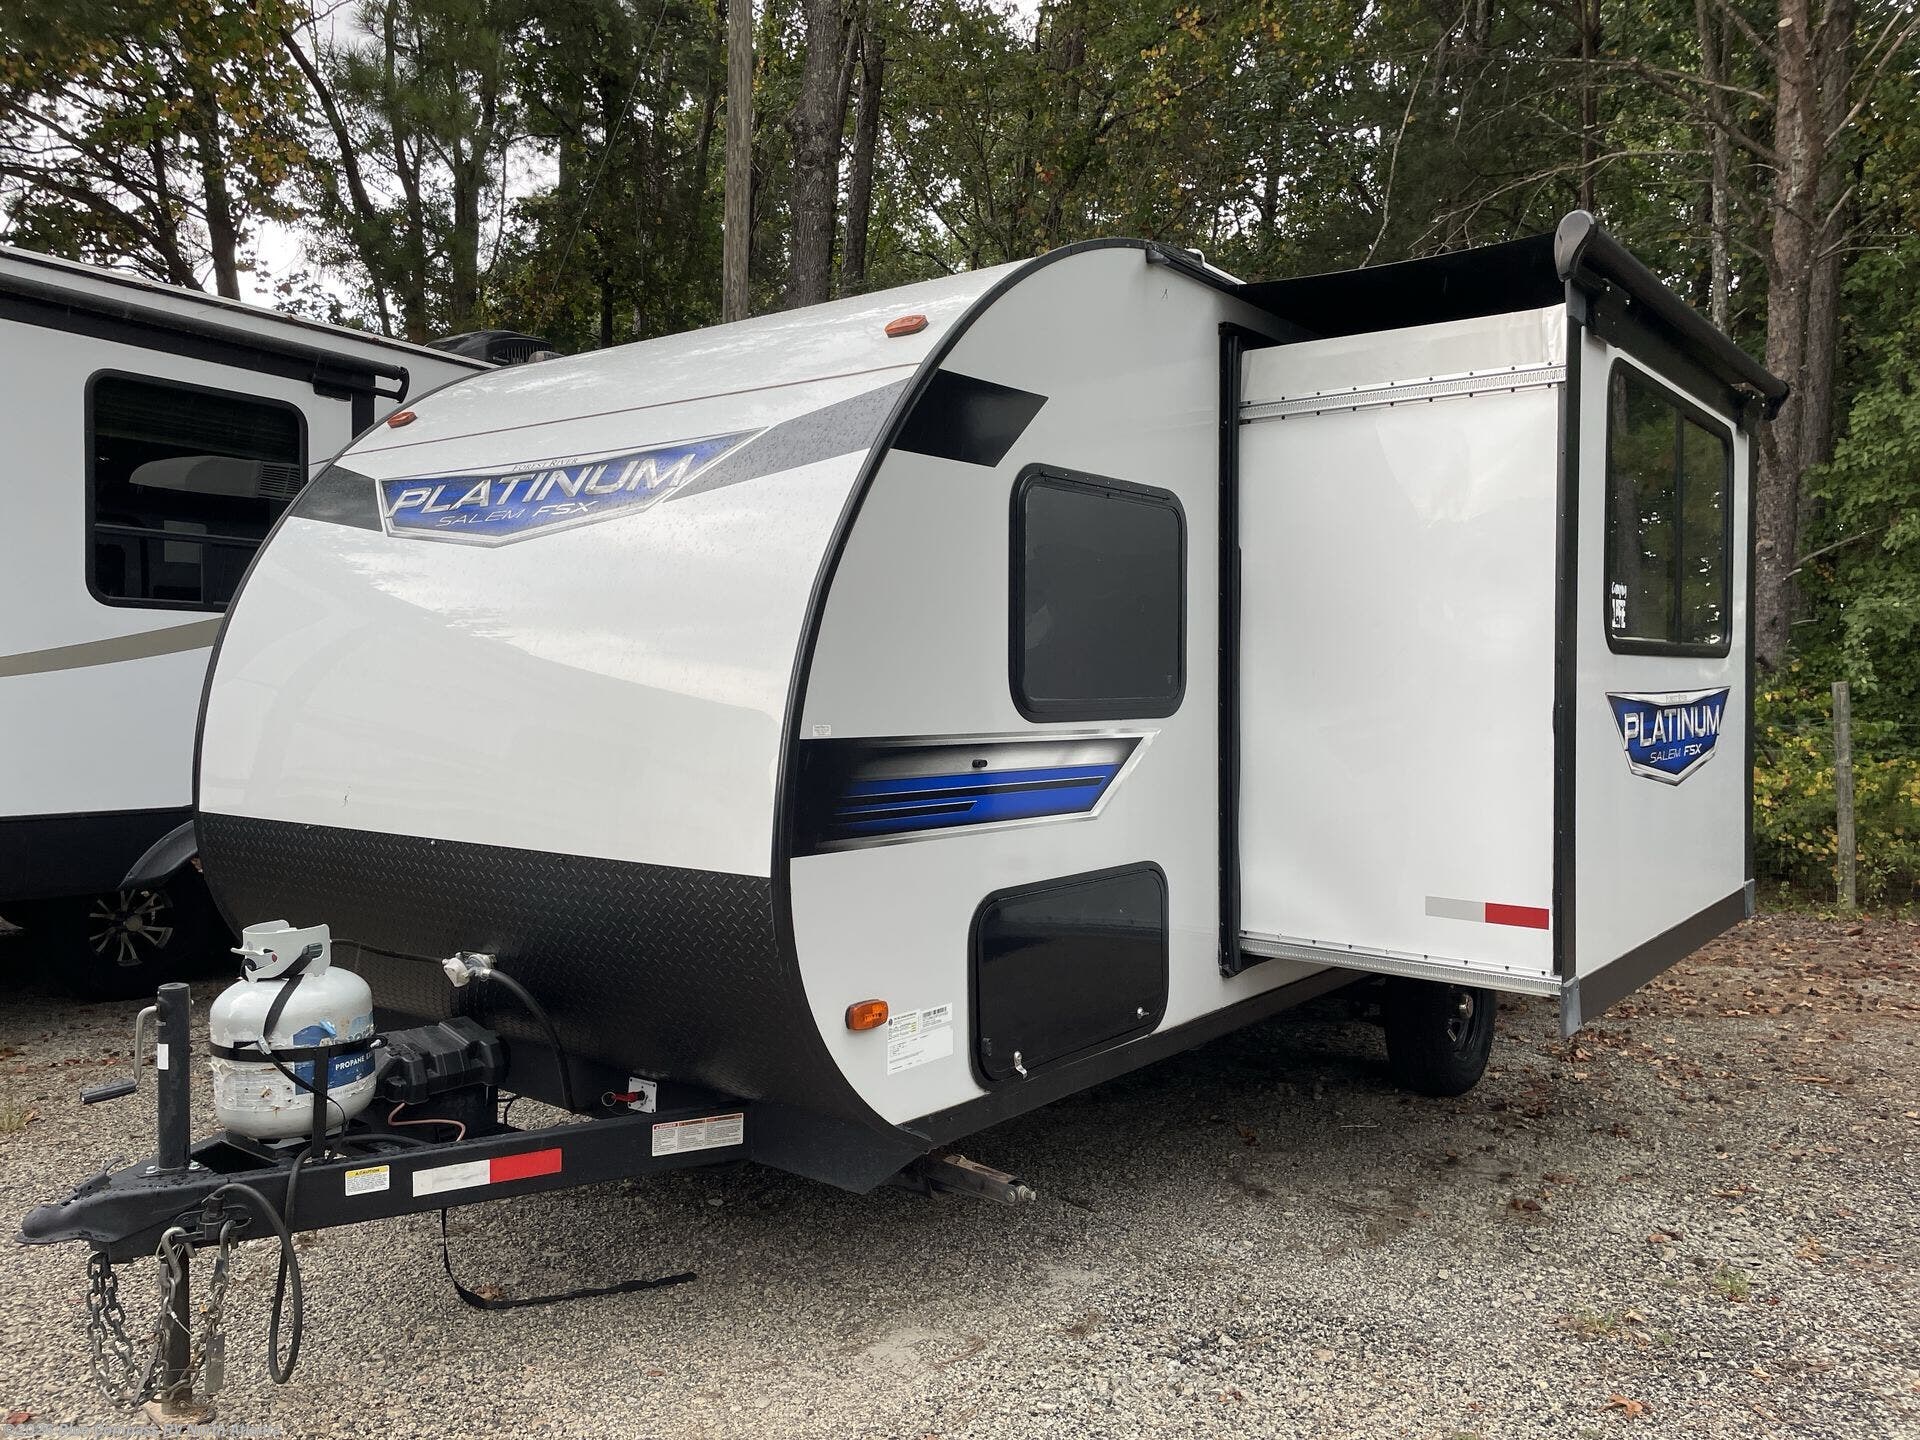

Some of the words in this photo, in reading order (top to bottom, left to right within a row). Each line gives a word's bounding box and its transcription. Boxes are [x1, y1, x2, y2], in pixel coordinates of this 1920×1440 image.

[549, 457, 578, 467] RIVER
[386, 453, 696, 518] PLATINUM
[436, 508, 526, 527] SALEM
[533, 500, 599, 517] FSX
[1624, 704, 1720, 751] PLATINUM
[1650, 748, 1682, 763] SALEM
[1683, 743, 1702, 757] FSX
[335, 1055, 365, 1071] PROPANE
